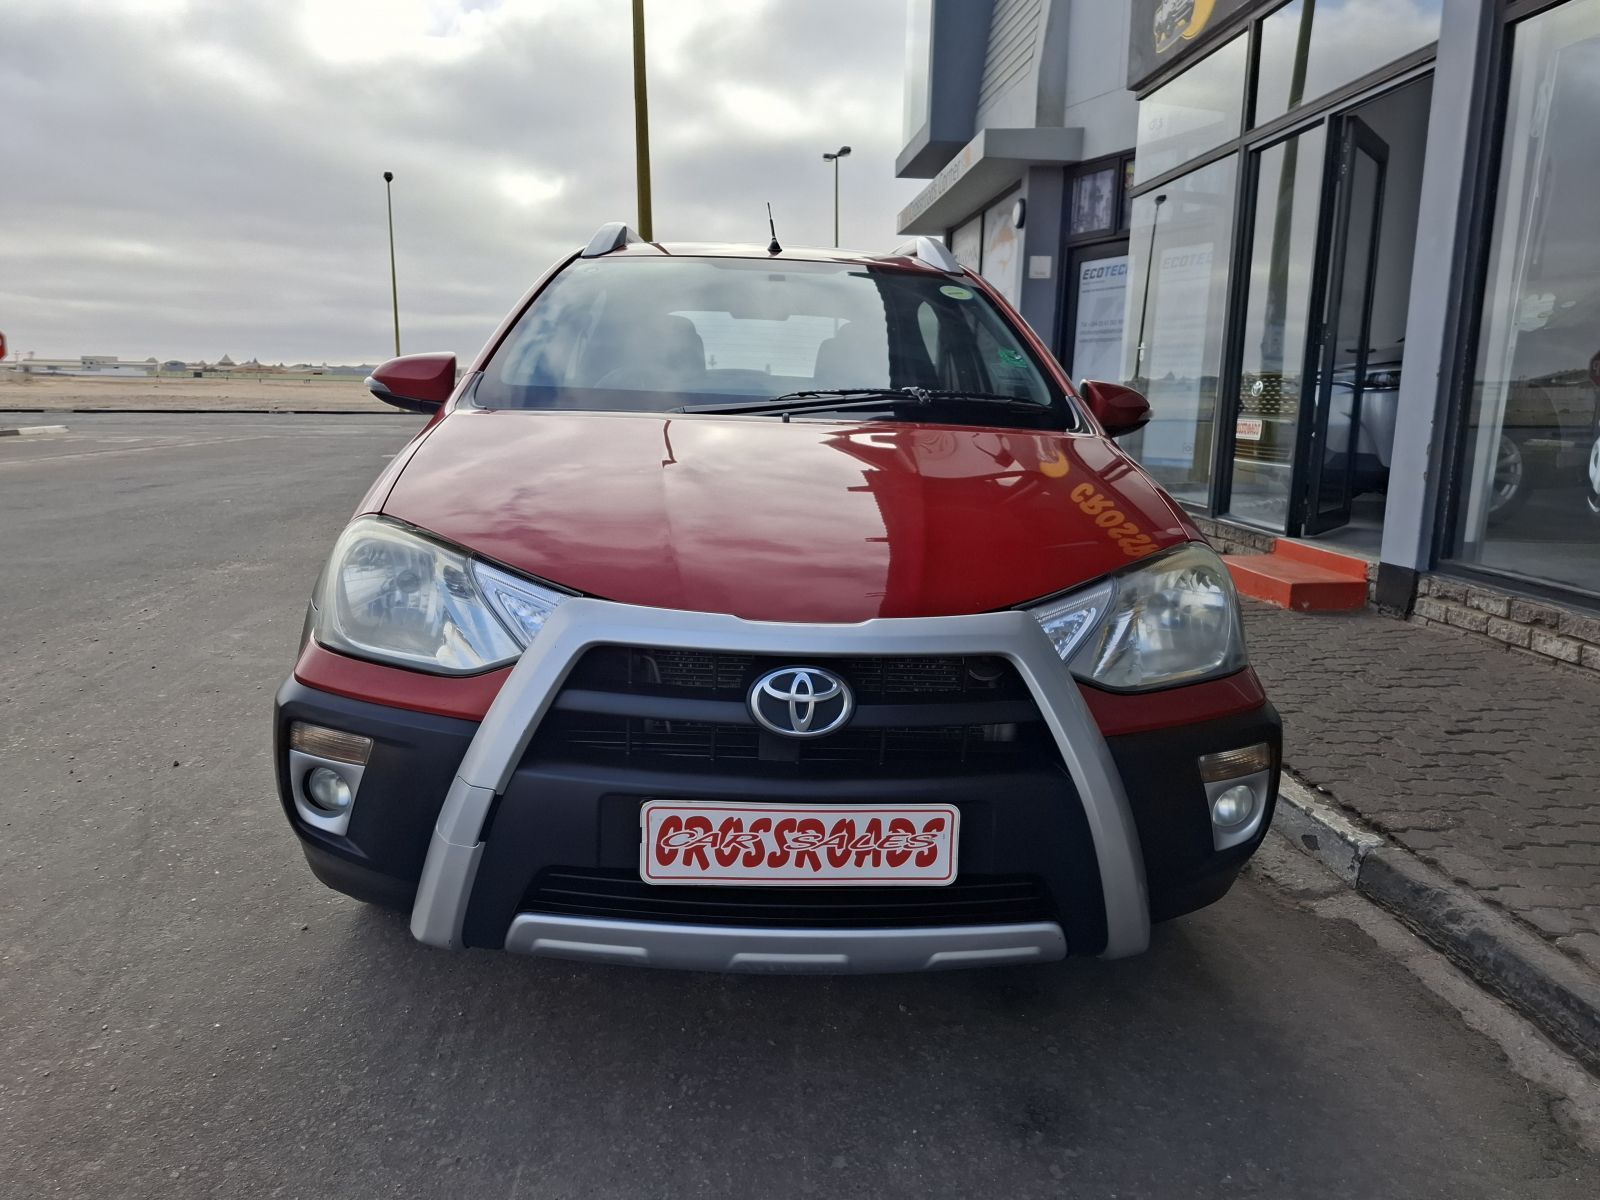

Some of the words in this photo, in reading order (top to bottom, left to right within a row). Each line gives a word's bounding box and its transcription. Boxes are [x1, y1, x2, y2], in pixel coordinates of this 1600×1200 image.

[655, 814, 946, 873] CROSSROADS
[660, 830, 762, 851] CAR
[783, 832, 938, 852] SALES
